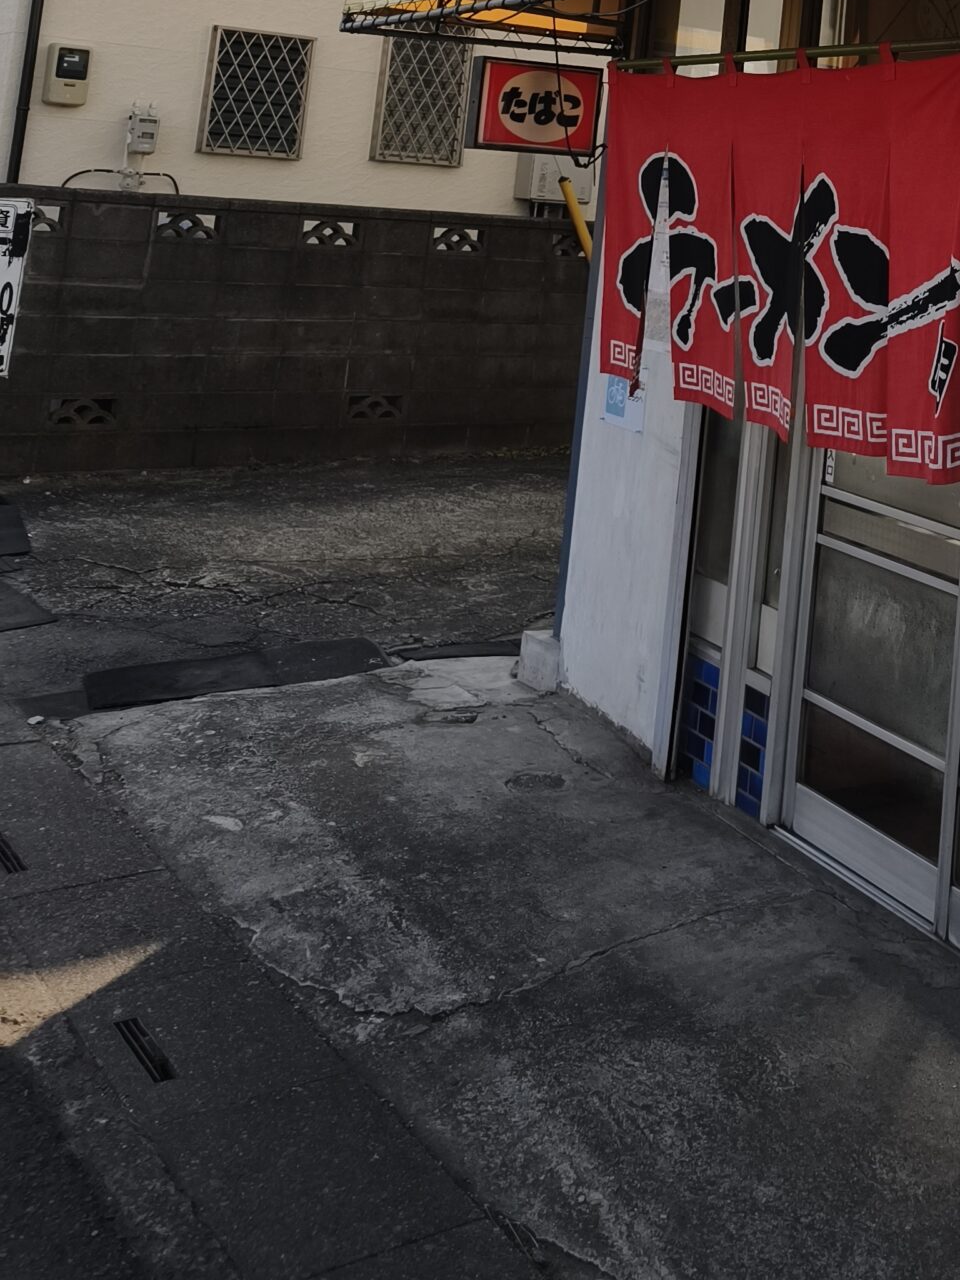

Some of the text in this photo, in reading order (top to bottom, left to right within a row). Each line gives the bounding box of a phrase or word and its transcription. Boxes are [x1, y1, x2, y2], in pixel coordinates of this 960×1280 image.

[501, 86, 581, 127] たばこ
[827, 449, 835, 477] 入口
